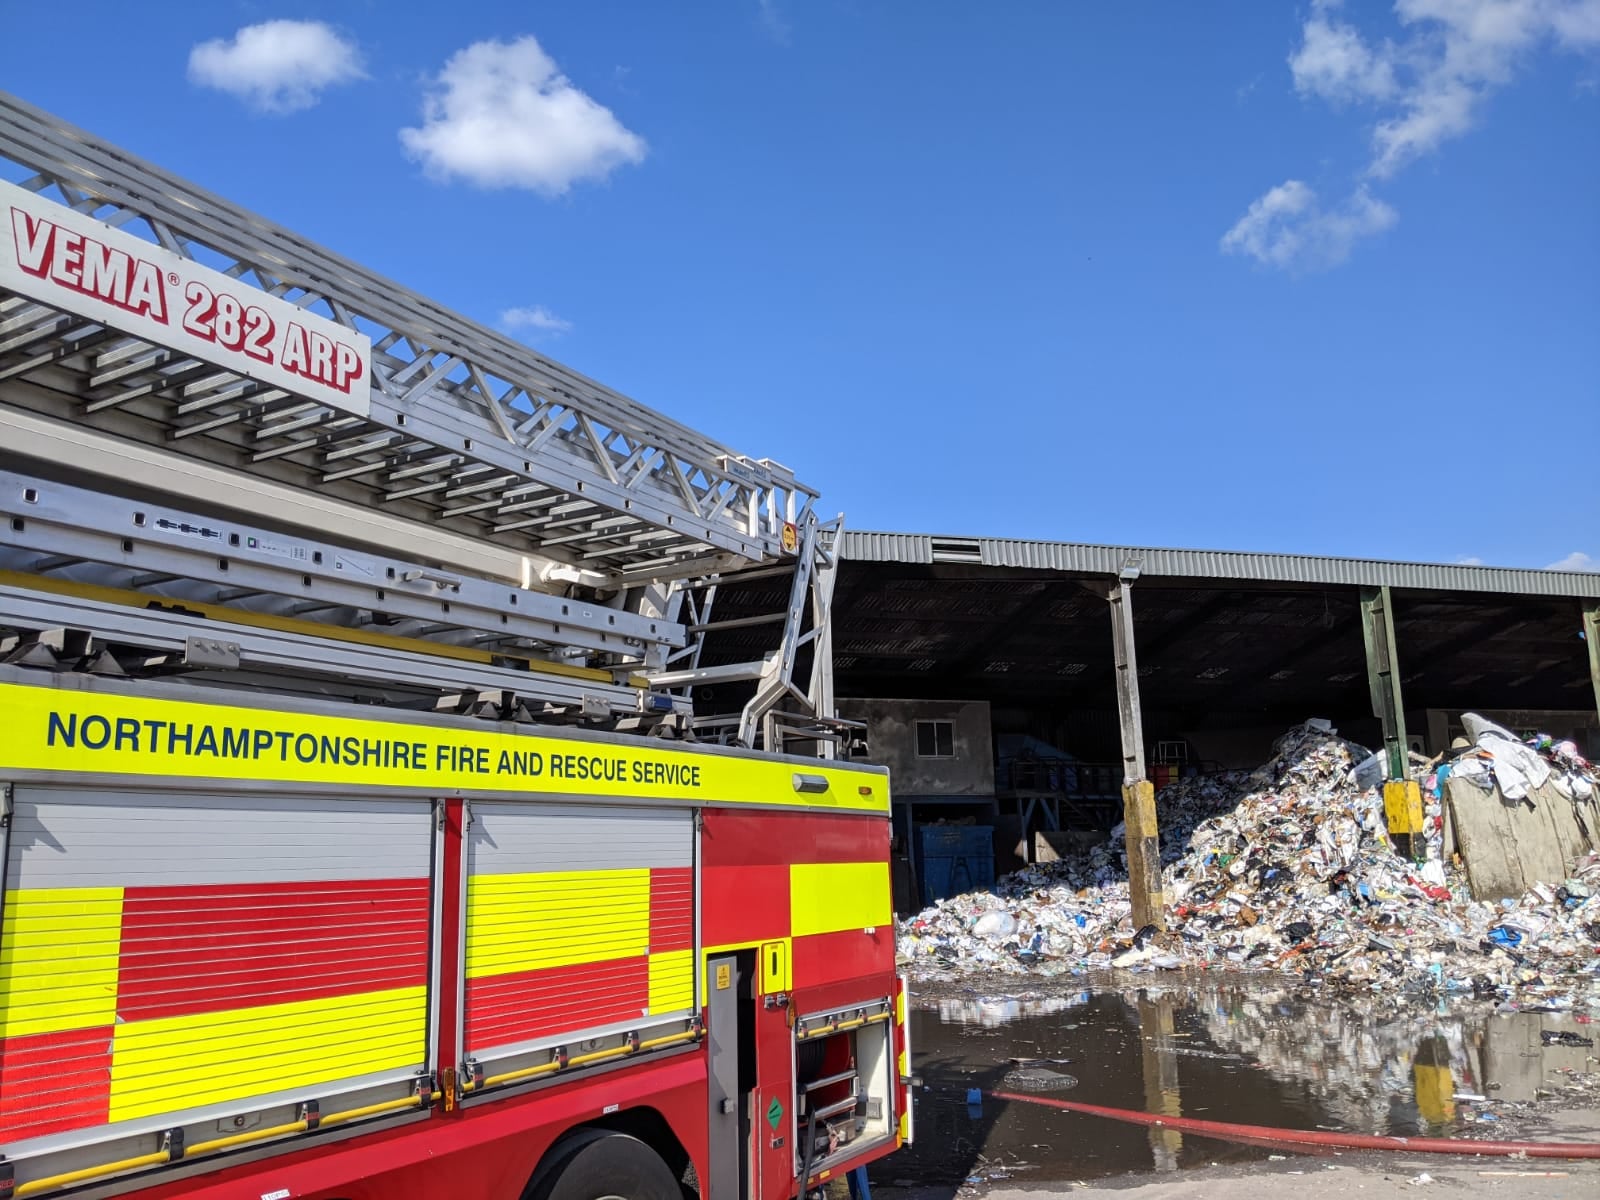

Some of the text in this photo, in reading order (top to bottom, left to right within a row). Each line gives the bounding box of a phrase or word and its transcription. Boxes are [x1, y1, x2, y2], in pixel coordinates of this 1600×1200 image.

[182, 281, 276, 365] 282
[281, 320, 363, 394] ARP
[47, 711, 701, 787] NORTHAMPTONSHIRE FIRE AND RESCUE SERVICE
